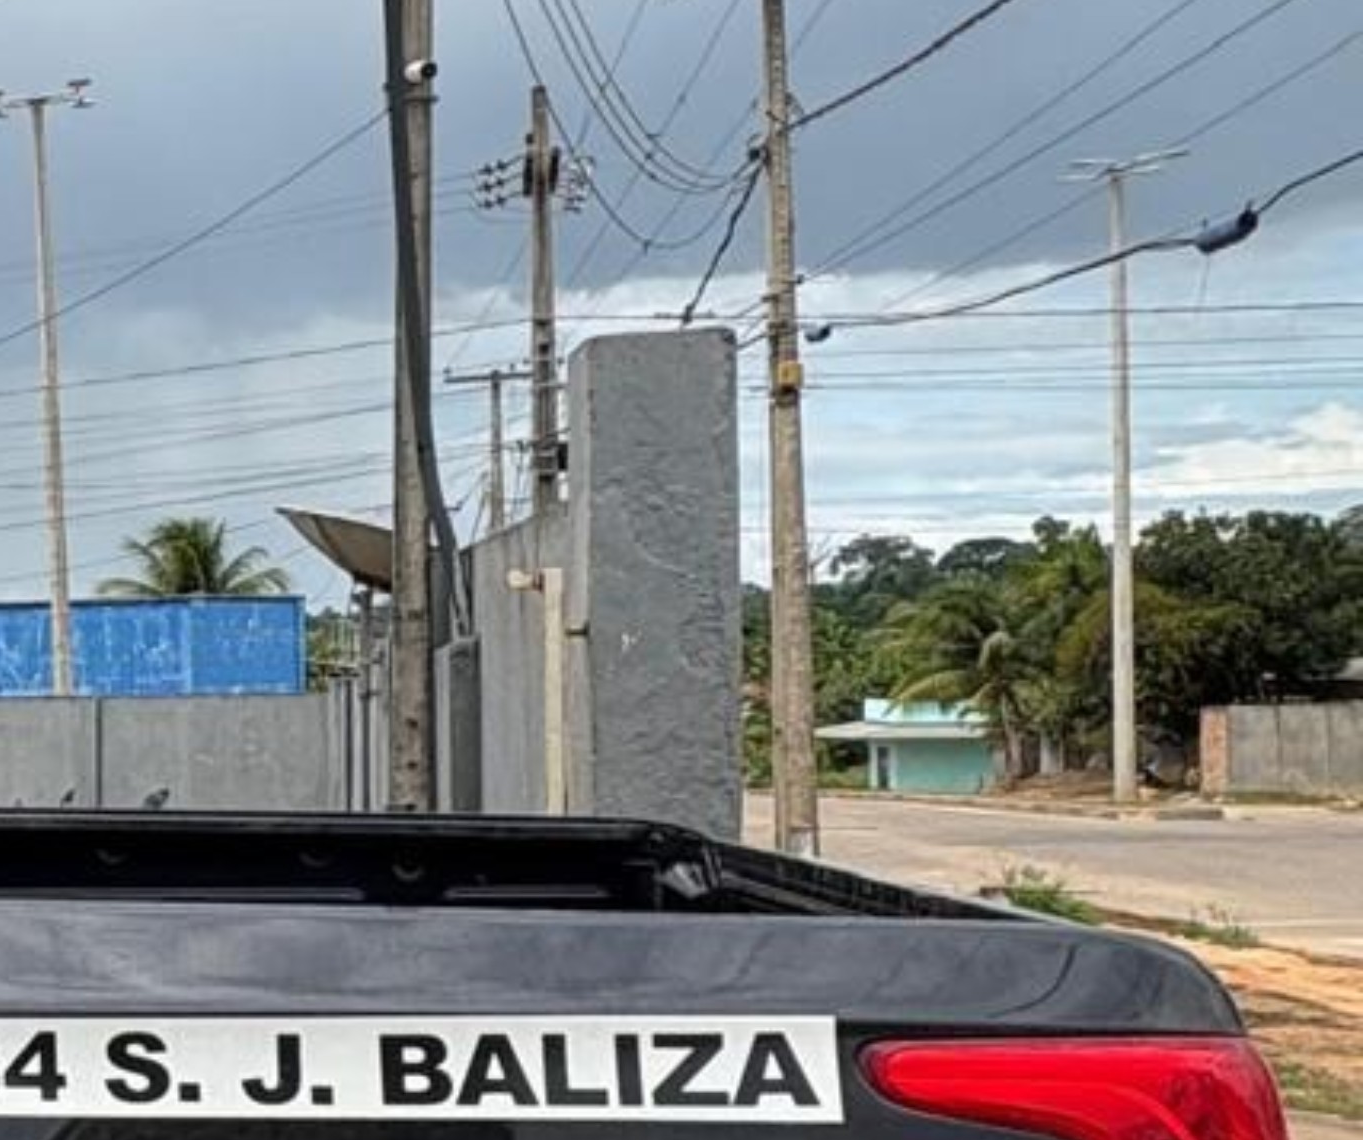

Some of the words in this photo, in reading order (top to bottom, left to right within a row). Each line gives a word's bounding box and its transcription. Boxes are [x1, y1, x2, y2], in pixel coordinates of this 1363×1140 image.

[105, 1031, 201, 1103] S.
[241, 1033, 333, 1105] J.
[379, 1033, 820, 1106] BALIZA
